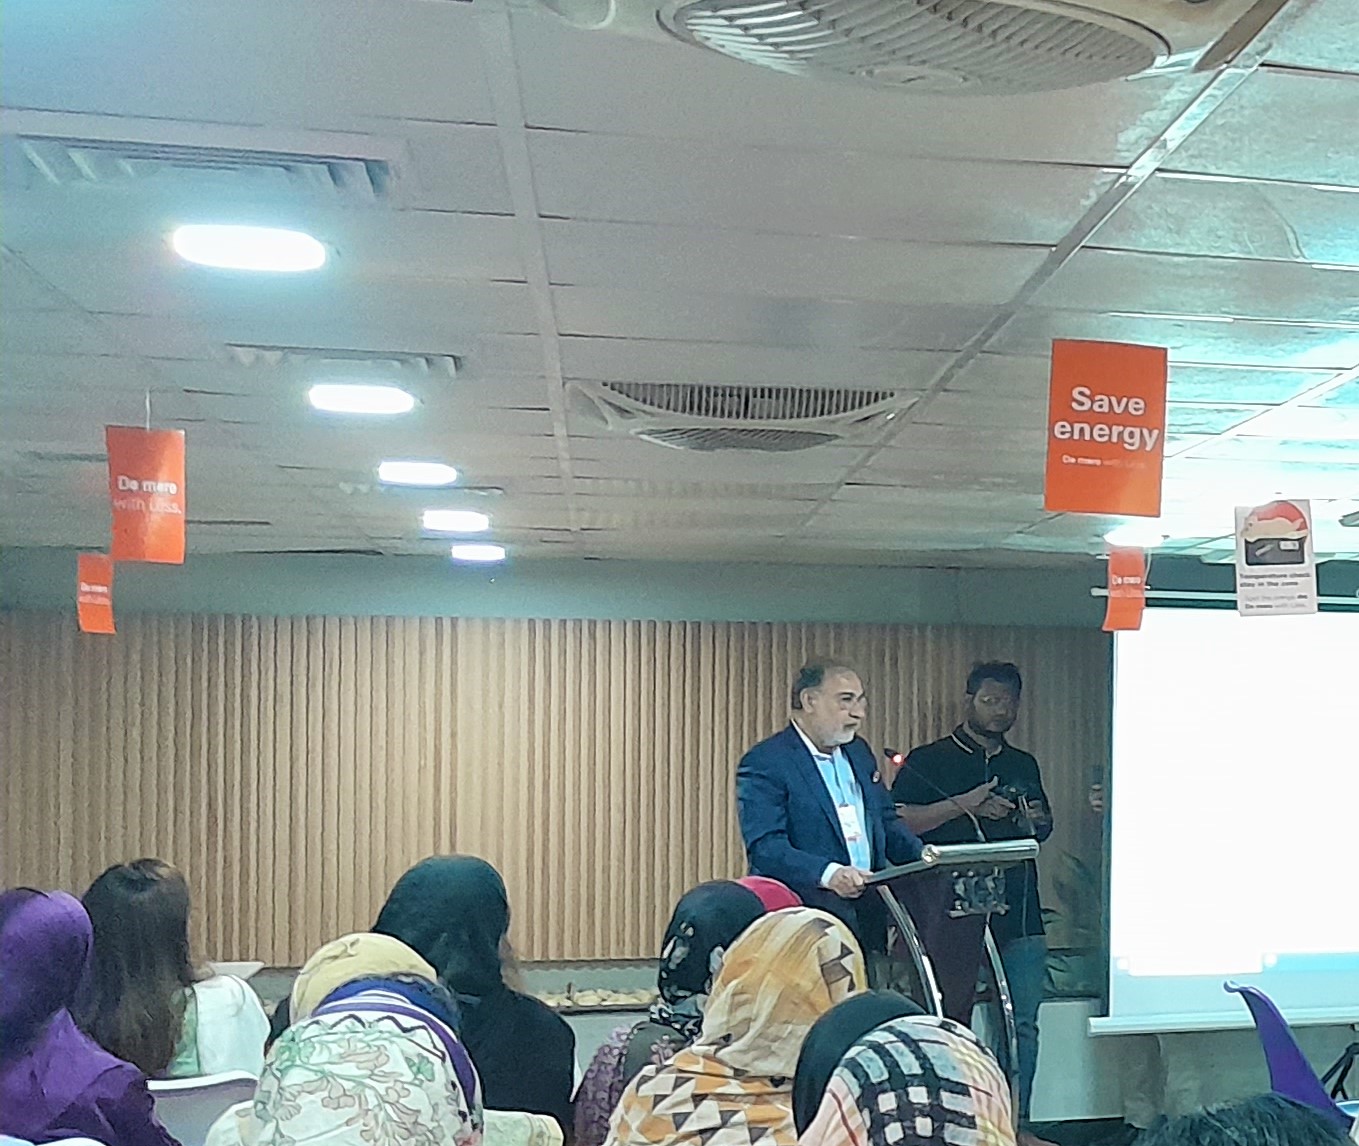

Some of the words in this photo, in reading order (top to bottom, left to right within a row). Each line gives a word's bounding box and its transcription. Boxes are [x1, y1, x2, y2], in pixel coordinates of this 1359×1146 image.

[1071, 386, 1146, 416] Save
[1054, 421, 1160, 451] energy
[117, 475, 139, 491] Do
[142, 481, 178, 495] more
